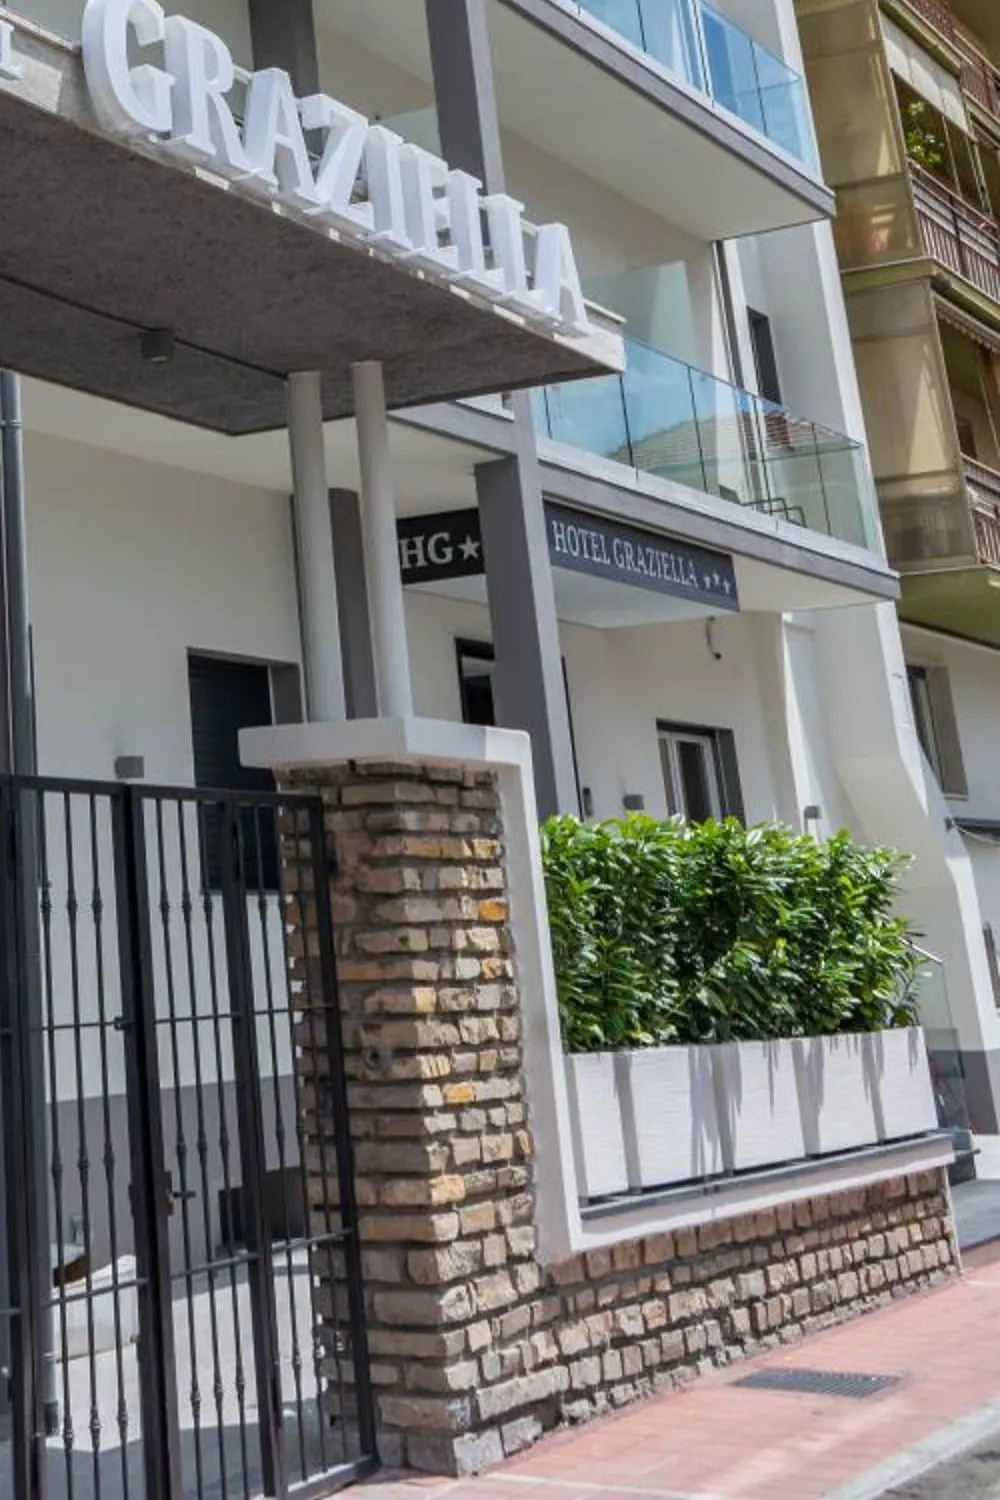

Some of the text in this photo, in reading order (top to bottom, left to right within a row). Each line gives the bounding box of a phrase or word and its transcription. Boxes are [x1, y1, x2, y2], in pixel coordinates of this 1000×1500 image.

[400, 531, 453, 569] HG
[552, 519, 699, 584] HOTEL GRAZIELLA
